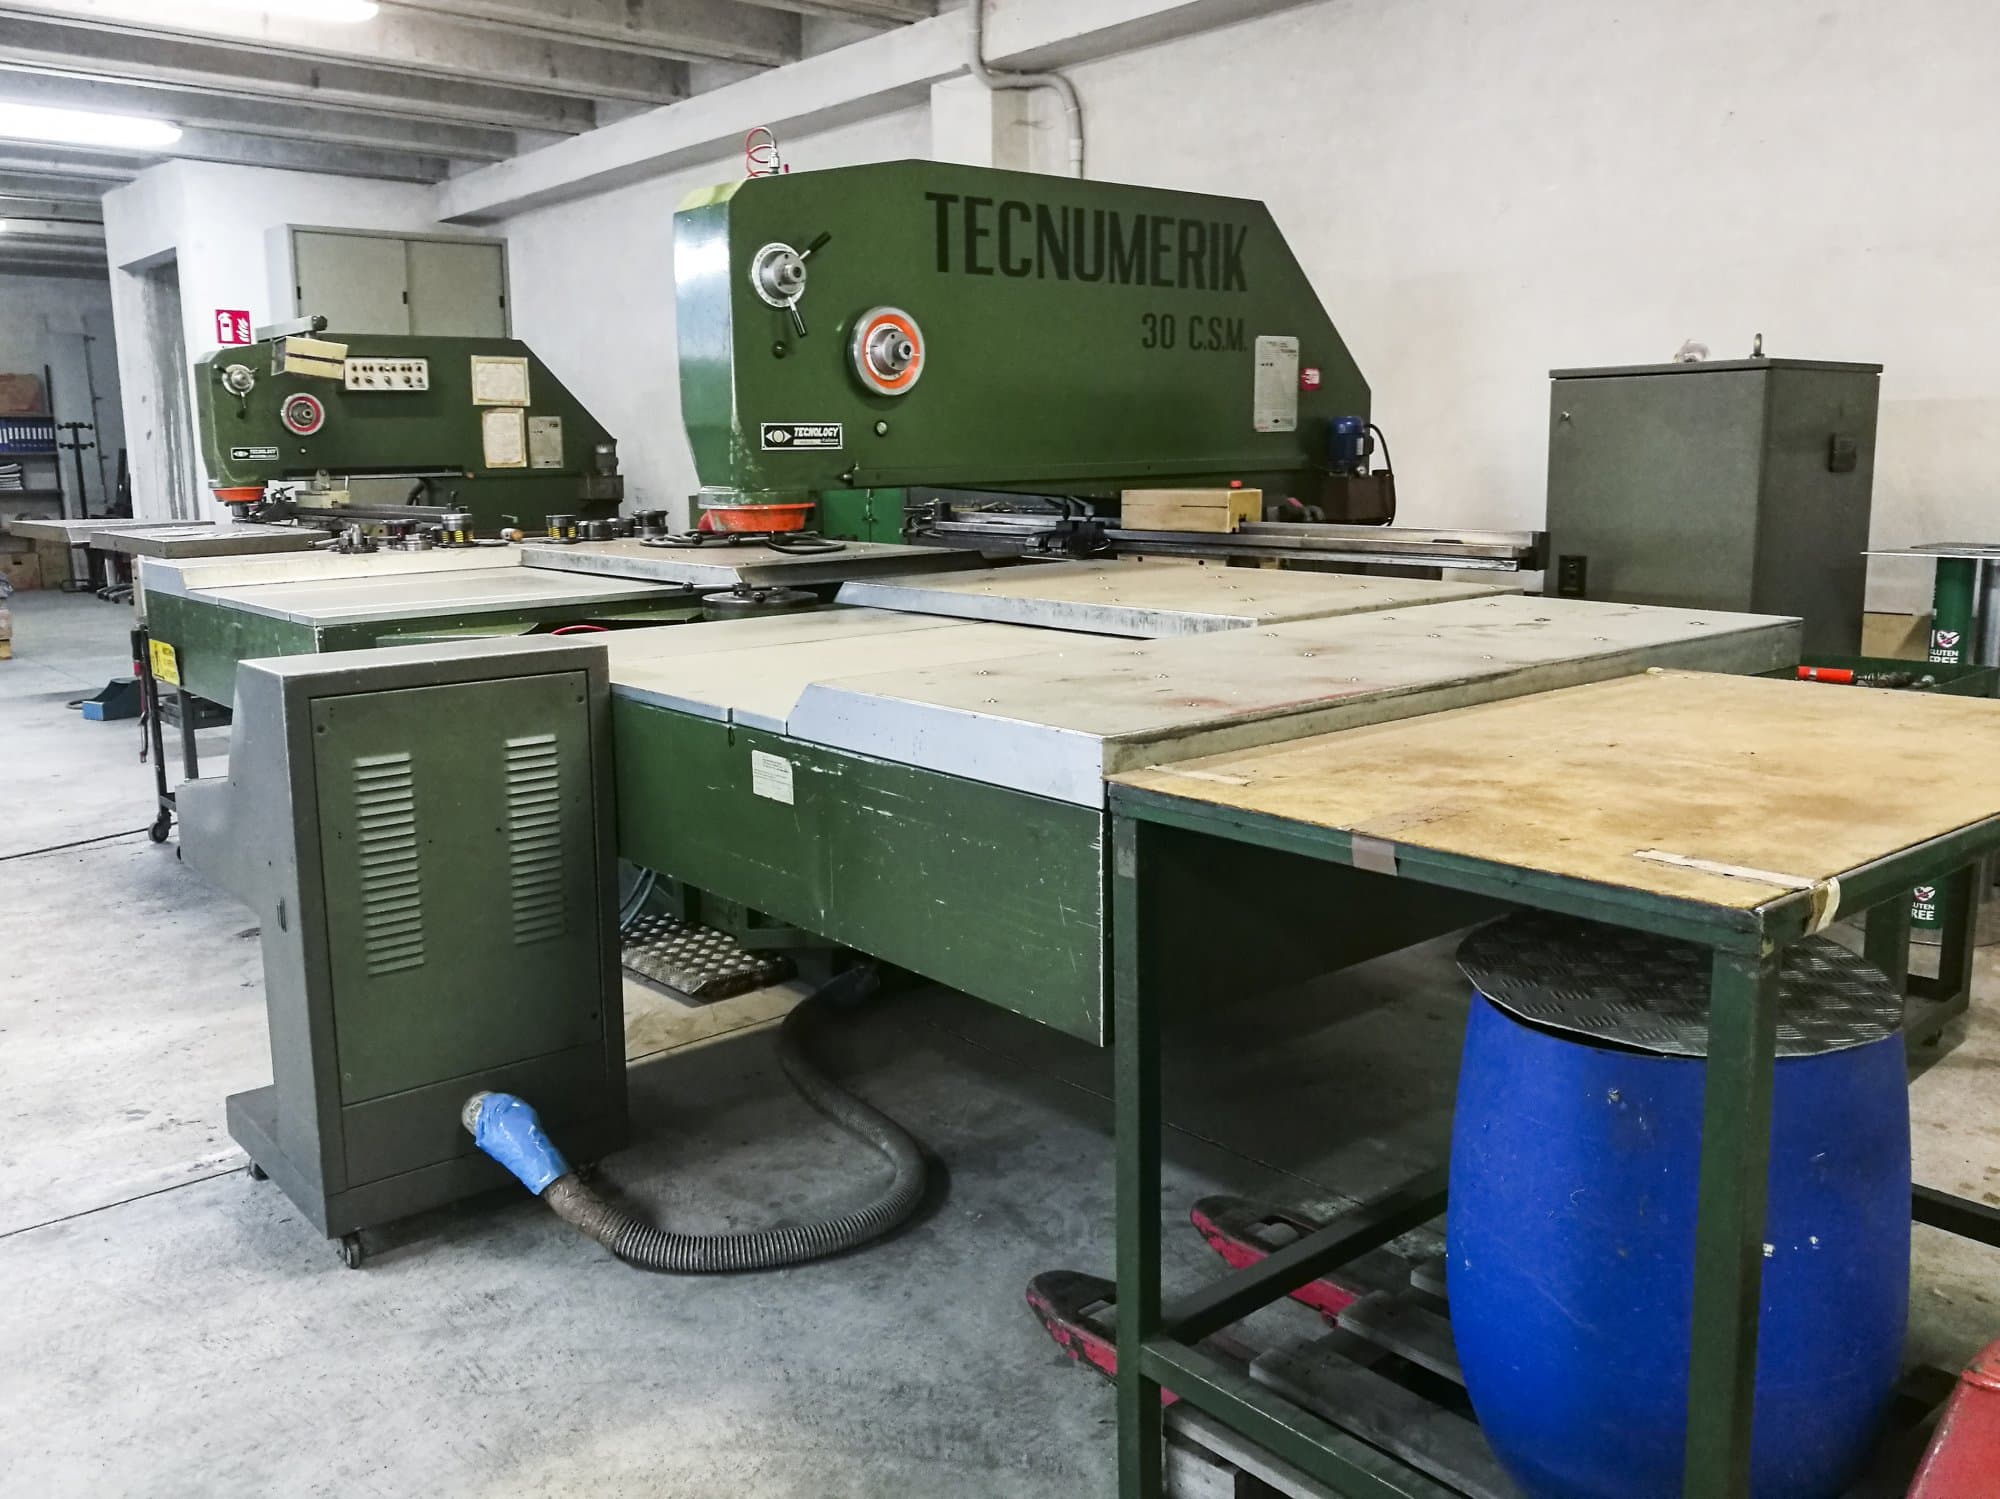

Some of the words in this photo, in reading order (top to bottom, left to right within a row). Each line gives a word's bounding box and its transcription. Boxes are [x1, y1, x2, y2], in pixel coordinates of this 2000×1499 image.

[925, 191, 1248, 292] TECNUMERIK
[1142, 312, 1176, 349] 30
[1189, 315, 1247, 352] C.S.M.
[794, 427, 839, 437] TECNOLOGY
[1911, 908, 1935, 921] REE
